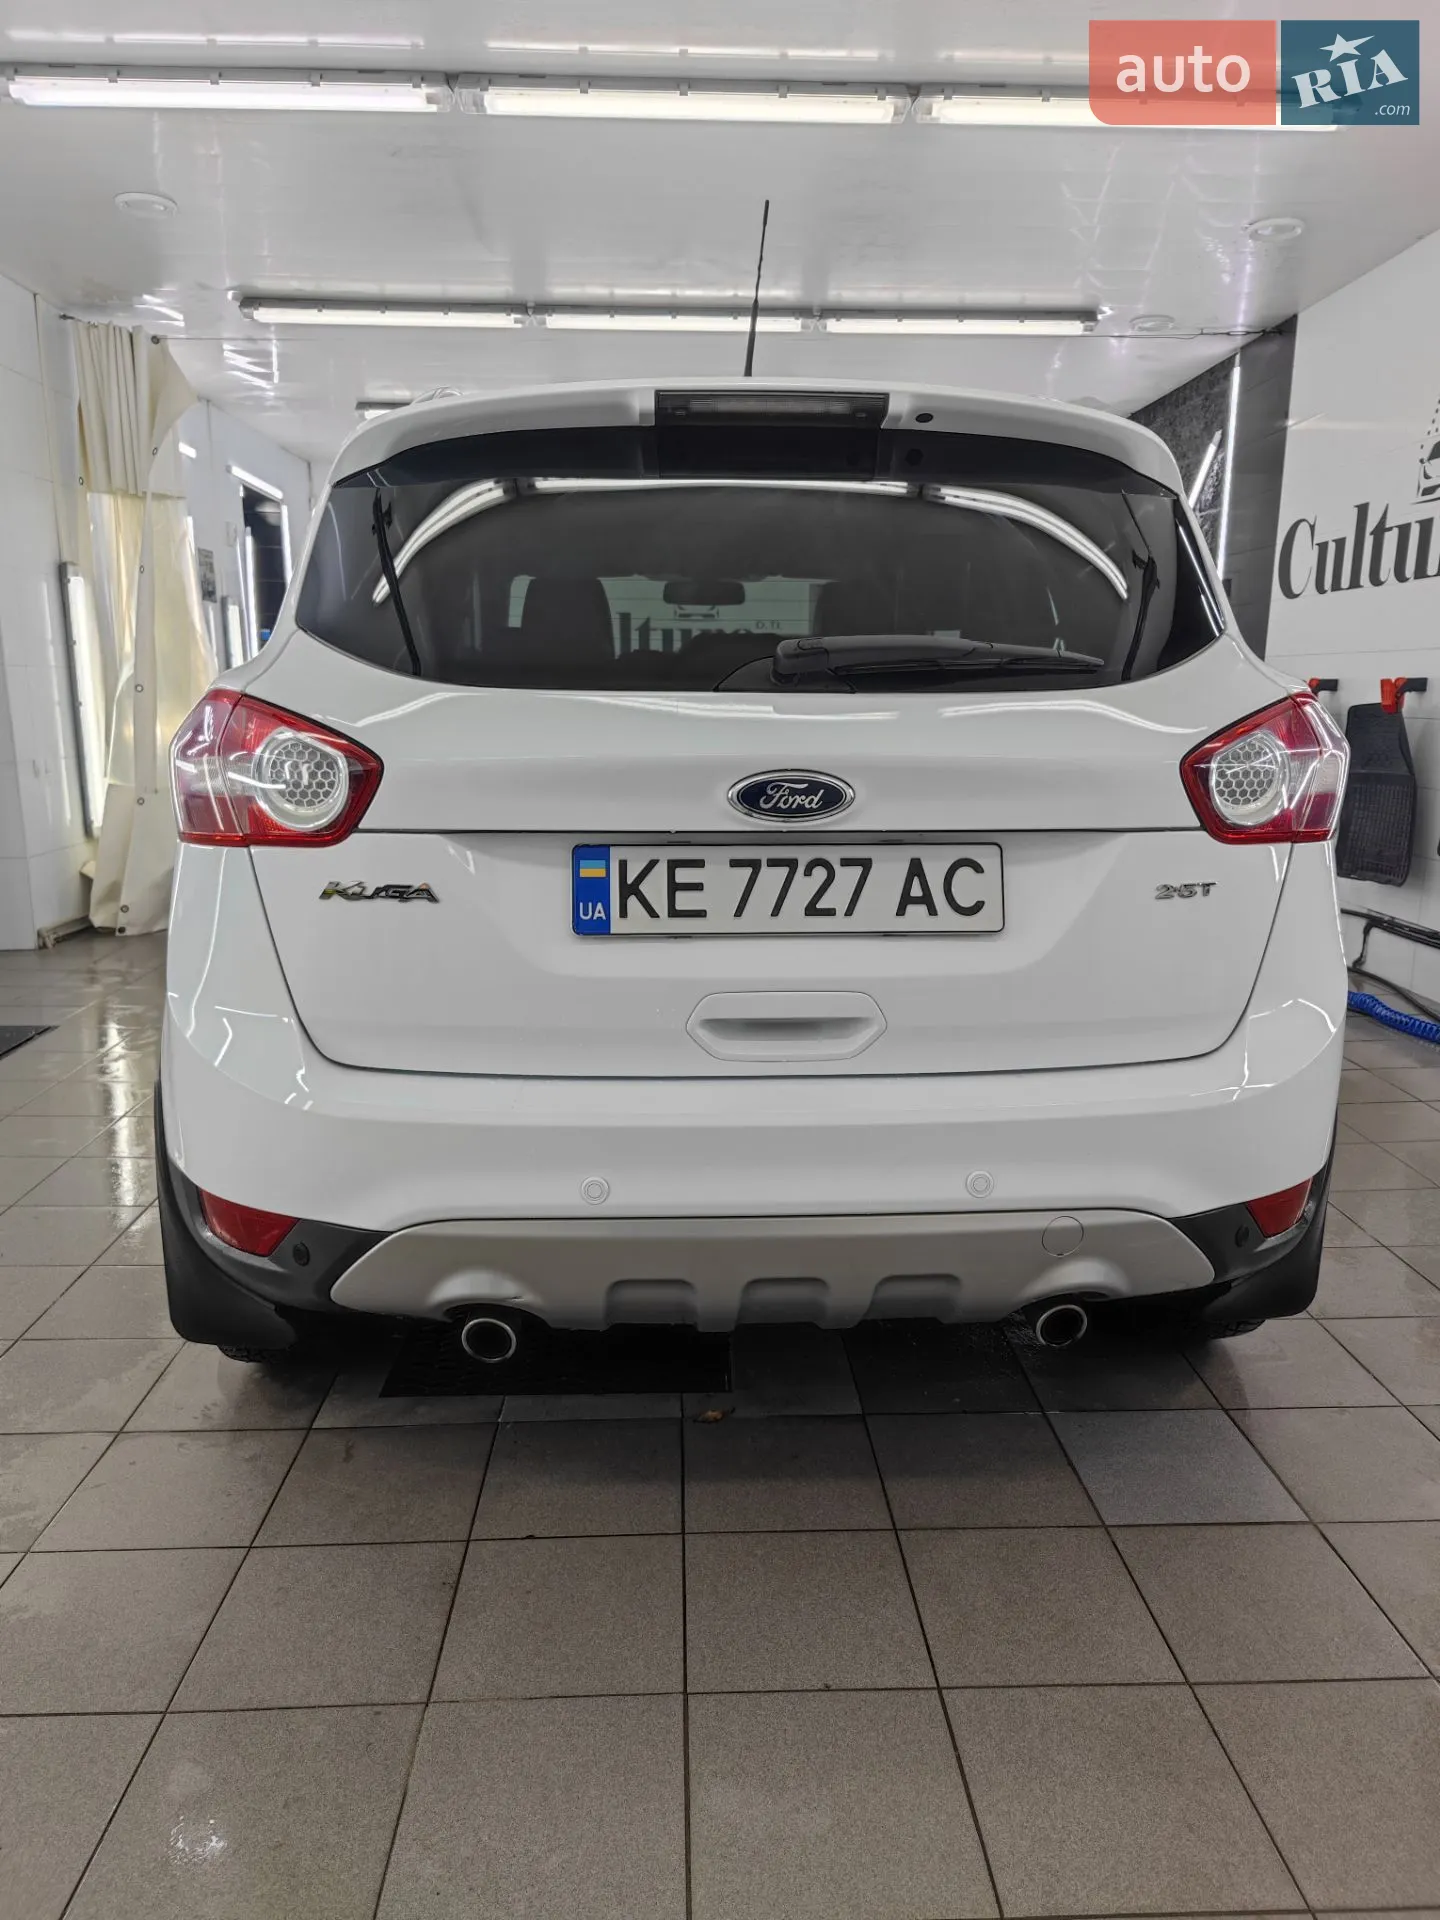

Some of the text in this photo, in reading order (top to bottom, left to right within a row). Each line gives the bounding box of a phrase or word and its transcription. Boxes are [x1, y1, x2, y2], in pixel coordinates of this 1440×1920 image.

[1278, 502, 1440, 600] Cultu
[759, 781, 825, 809] Ford
[618, 857, 985, 918] KE 7727 AC
[579, 902, 606, 920] UA
